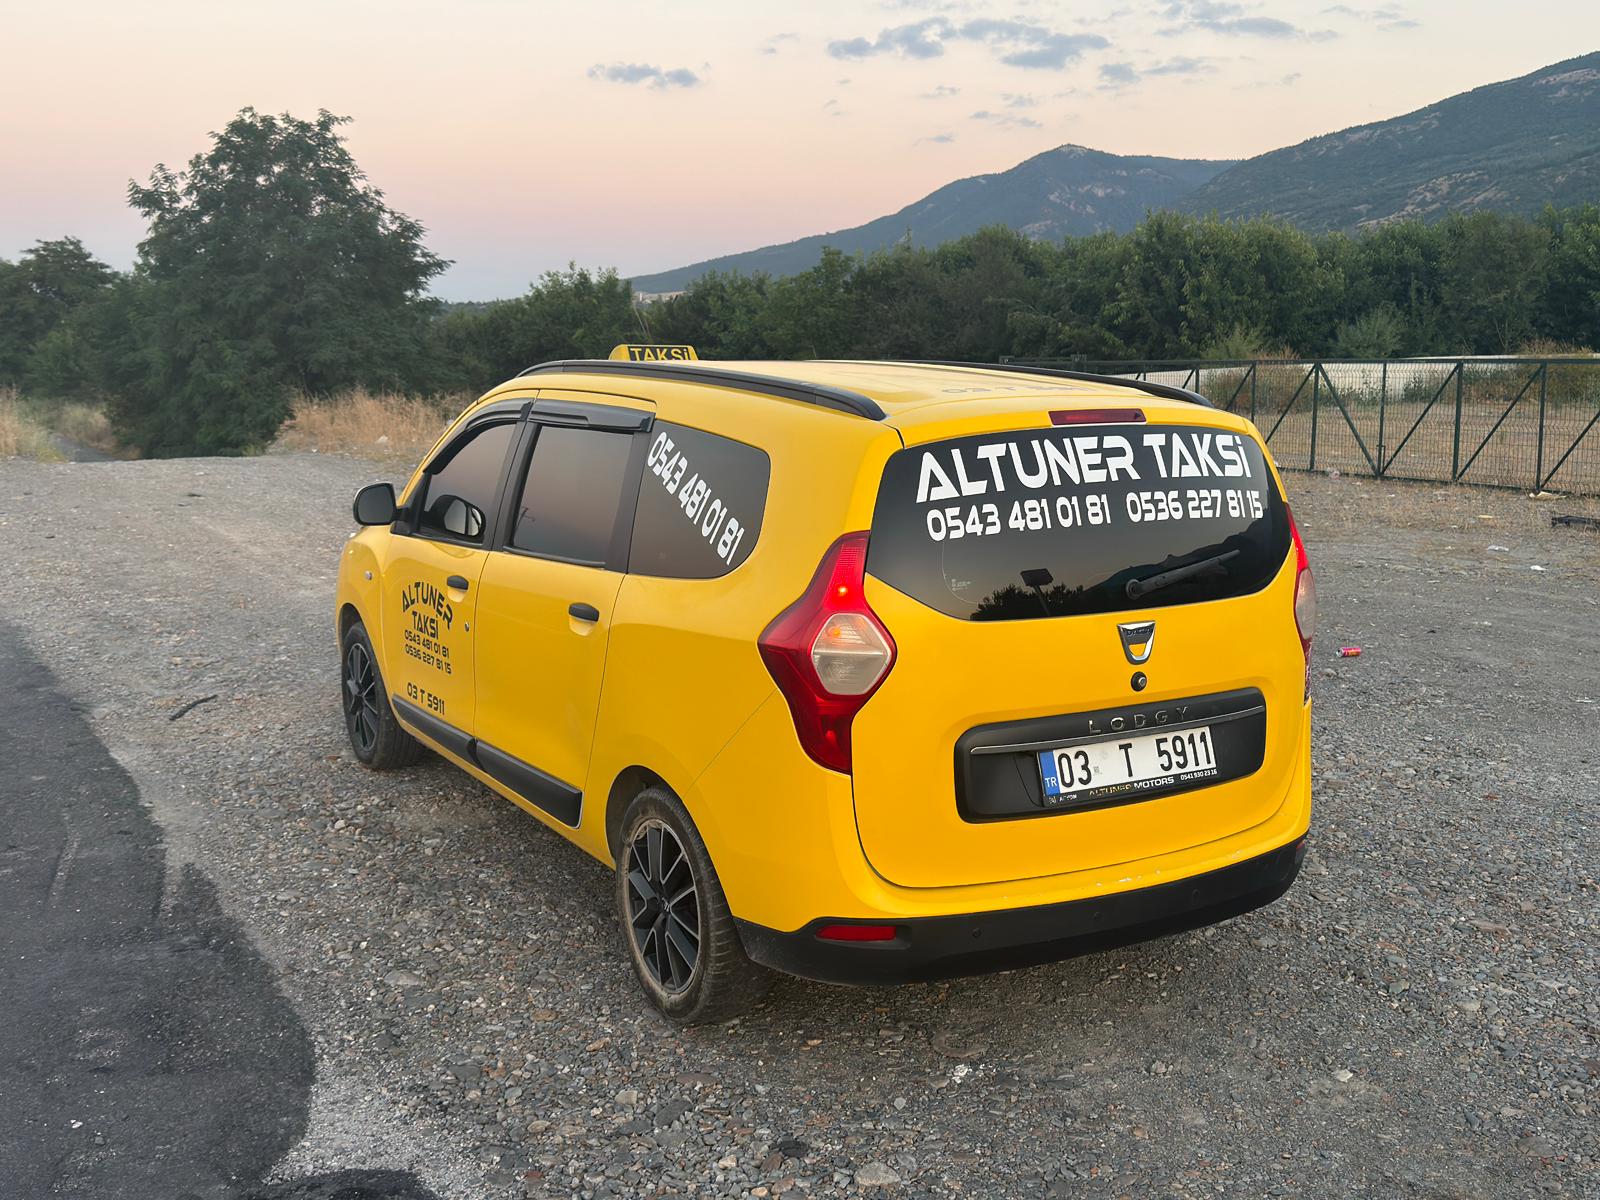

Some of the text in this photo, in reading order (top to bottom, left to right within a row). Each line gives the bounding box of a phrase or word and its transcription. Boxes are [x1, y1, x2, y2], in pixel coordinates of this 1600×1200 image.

[916, 435, 1141, 503] ALTUNER
[647, 431, 745, 566] 0543 481 01 81
[926, 489, 1264, 541] 0543 481 01 81 0536 227 81 15
[402, 581, 453, 630] ALTUNER
[405, 630, 450, 659] 0543 481 01 81
[405, 643, 452, 675] 0536 227 81 15
[407, 682, 445, 715] 03 T 5911
[1088, 706, 1188, 734] LODGY
[1044, 731, 1211, 788] TR 03 T 5911
[1134, 776, 1175, 789] MOTORS
